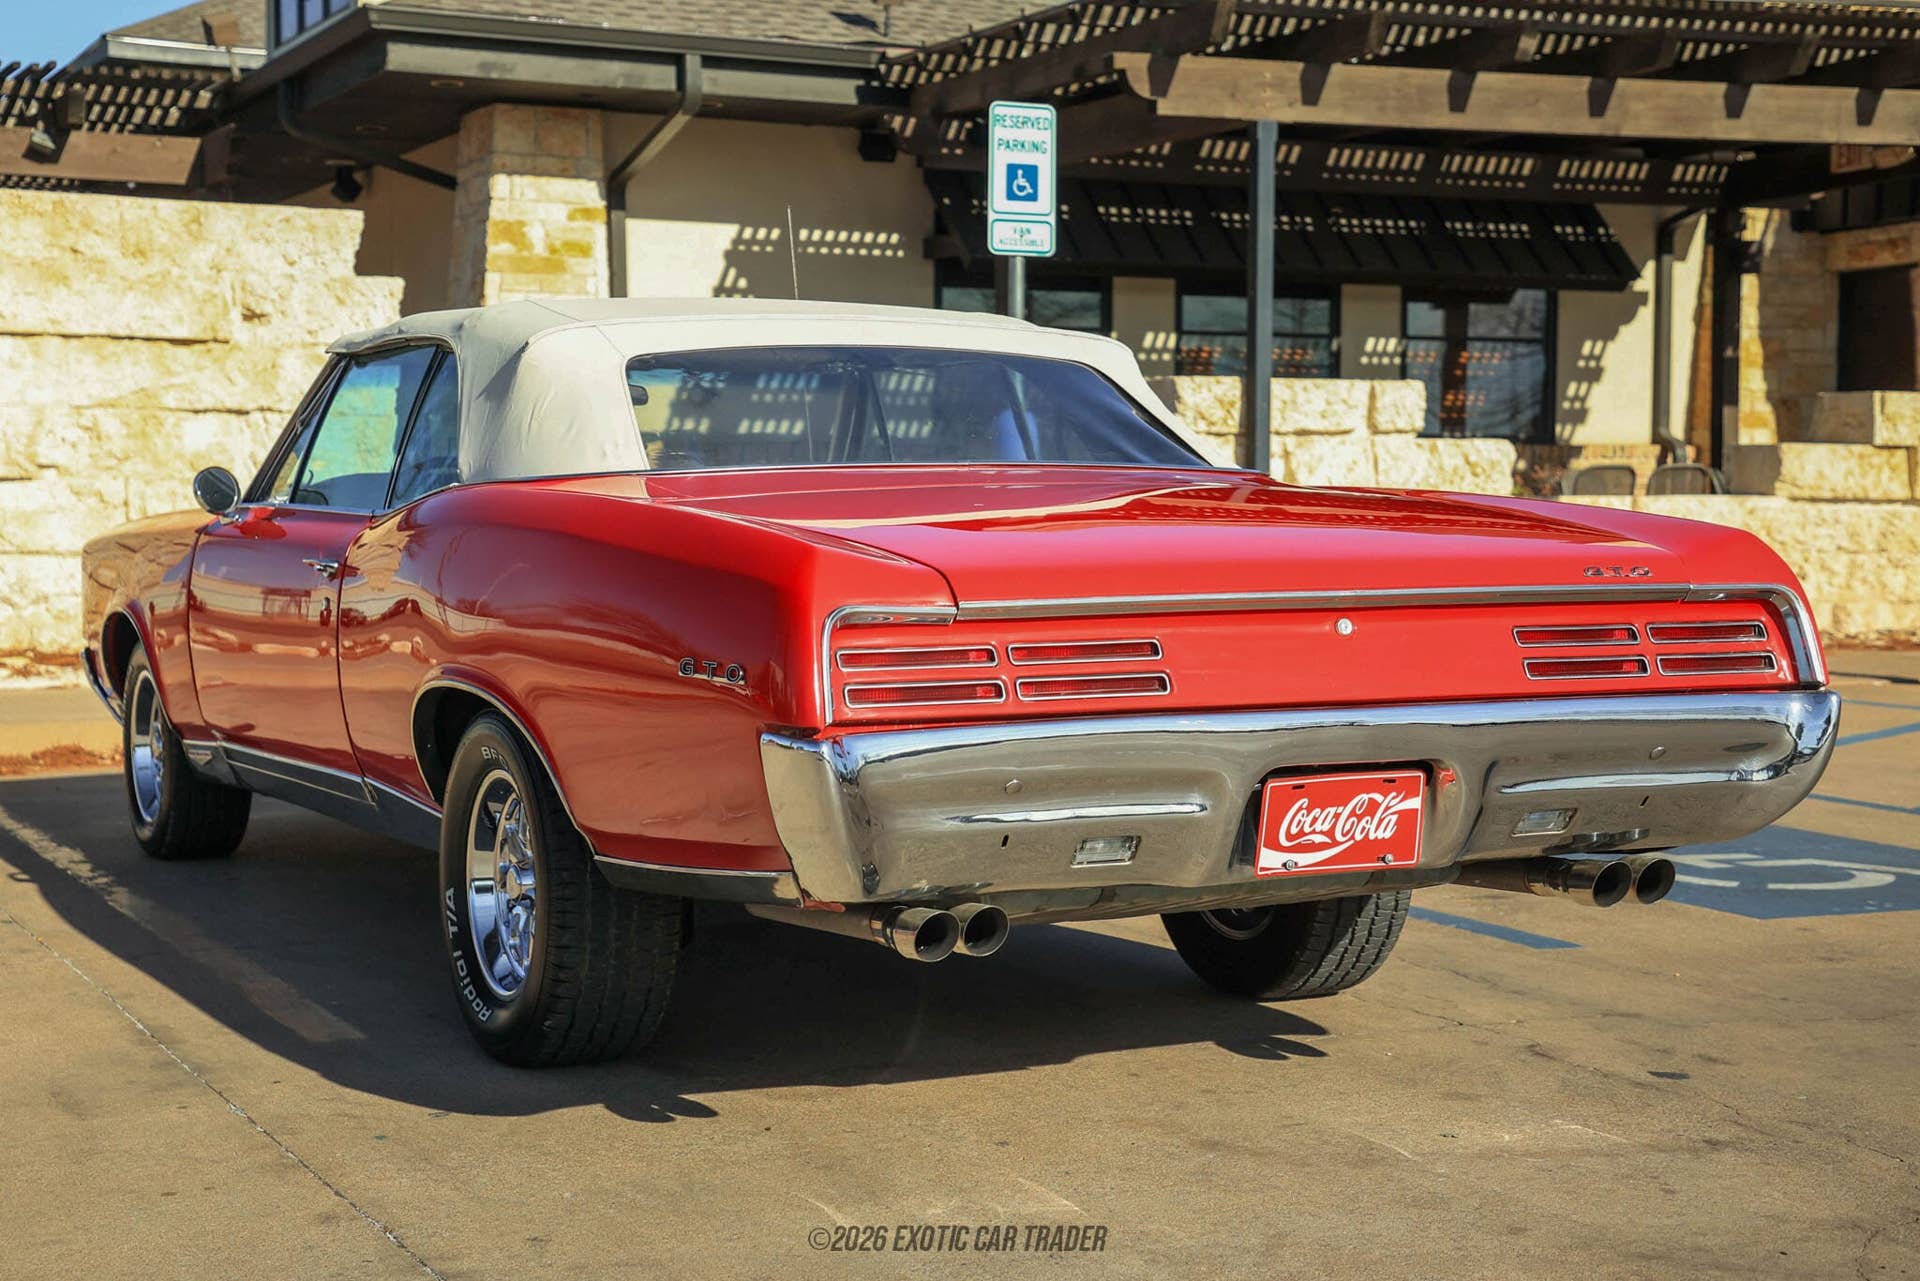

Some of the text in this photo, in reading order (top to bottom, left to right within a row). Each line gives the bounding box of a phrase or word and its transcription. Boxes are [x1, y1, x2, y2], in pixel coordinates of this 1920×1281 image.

[994, 113, 1051, 130] RESERVED
[997, 138, 1048, 154] PARKING
[679, 657, 744, 684] GTO
[1278, 791, 1406, 847] Coca-Cola
[445, 887, 458, 939] T/A
